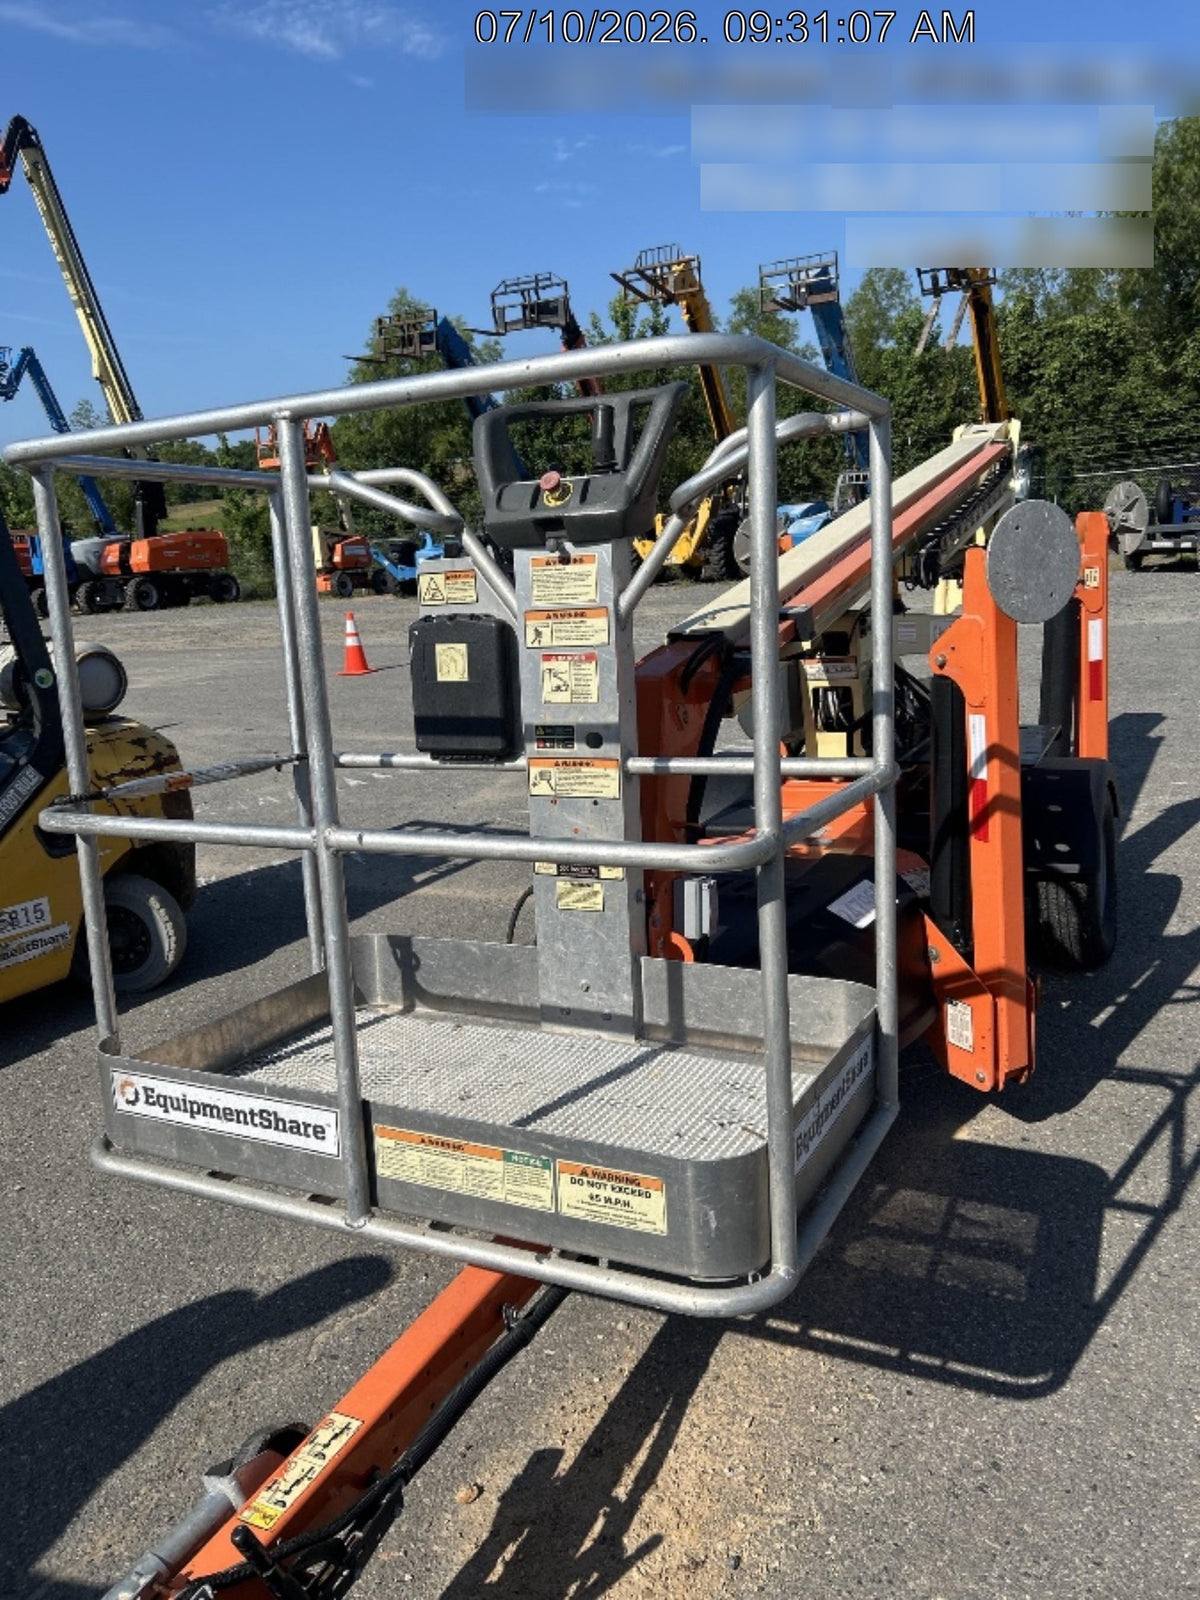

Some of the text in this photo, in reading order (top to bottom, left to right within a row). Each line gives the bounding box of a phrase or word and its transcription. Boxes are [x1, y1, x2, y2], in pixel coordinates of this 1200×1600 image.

[141, 1085, 327, 1141] EquipmentShare
[569, 1176, 653, 1200] DO NOT EXCEED
[591, 1169, 641, 1188] WARNING
